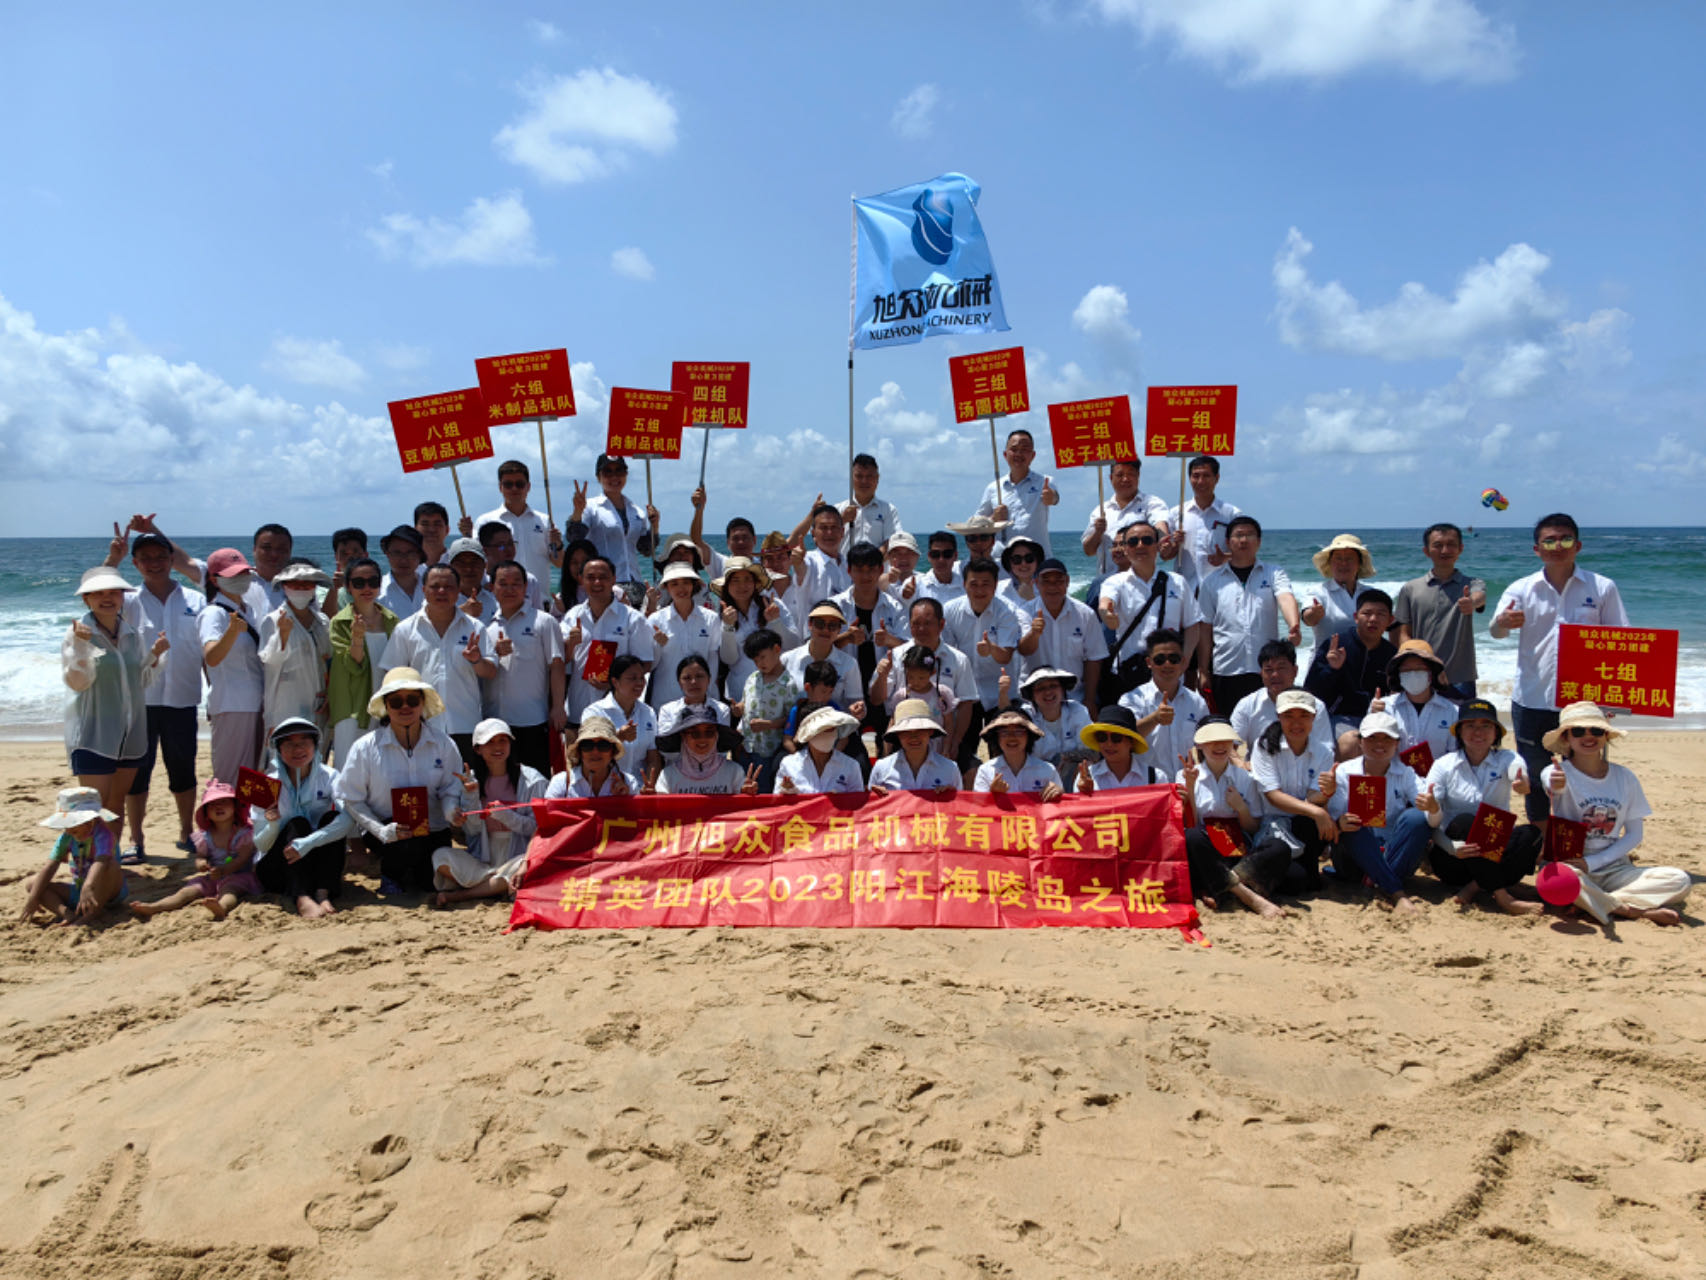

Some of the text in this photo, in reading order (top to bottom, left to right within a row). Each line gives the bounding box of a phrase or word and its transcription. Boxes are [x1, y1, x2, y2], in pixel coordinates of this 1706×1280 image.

[870, 325, 924, 341] XUZHON
[510, 380, 544, 398] 六组
[693, 385, 727, 402] 四组
[973, 373, 1007, 394] 三组
[488, 395, 573, 419] 米制品机队
[682, 406, 743, 425] 饼机队
[632, 417, 660, 433] 五组
[1074, 421, 1111, 439] 二组
[1171, 411, 1211, 429] 一组
[427, 421, 461, 441] 八组
[403, 435, 490, 465] 豆制品机队
[610, 434, 679, 452] 肉制品机队
[1058, 440, 1133, 465] 饺子机队
[1150, 433, 1231, 453] 包子机队
[1594, 662, 1638, 682] 七组
[1560, 681, 1671, 708] 菜制品机队
[596, 813, 1131, 855] 广州旭众食品机械有限公司
[558, 866, 1169, 914] 精英团队2023阳江海陵岛之旅
